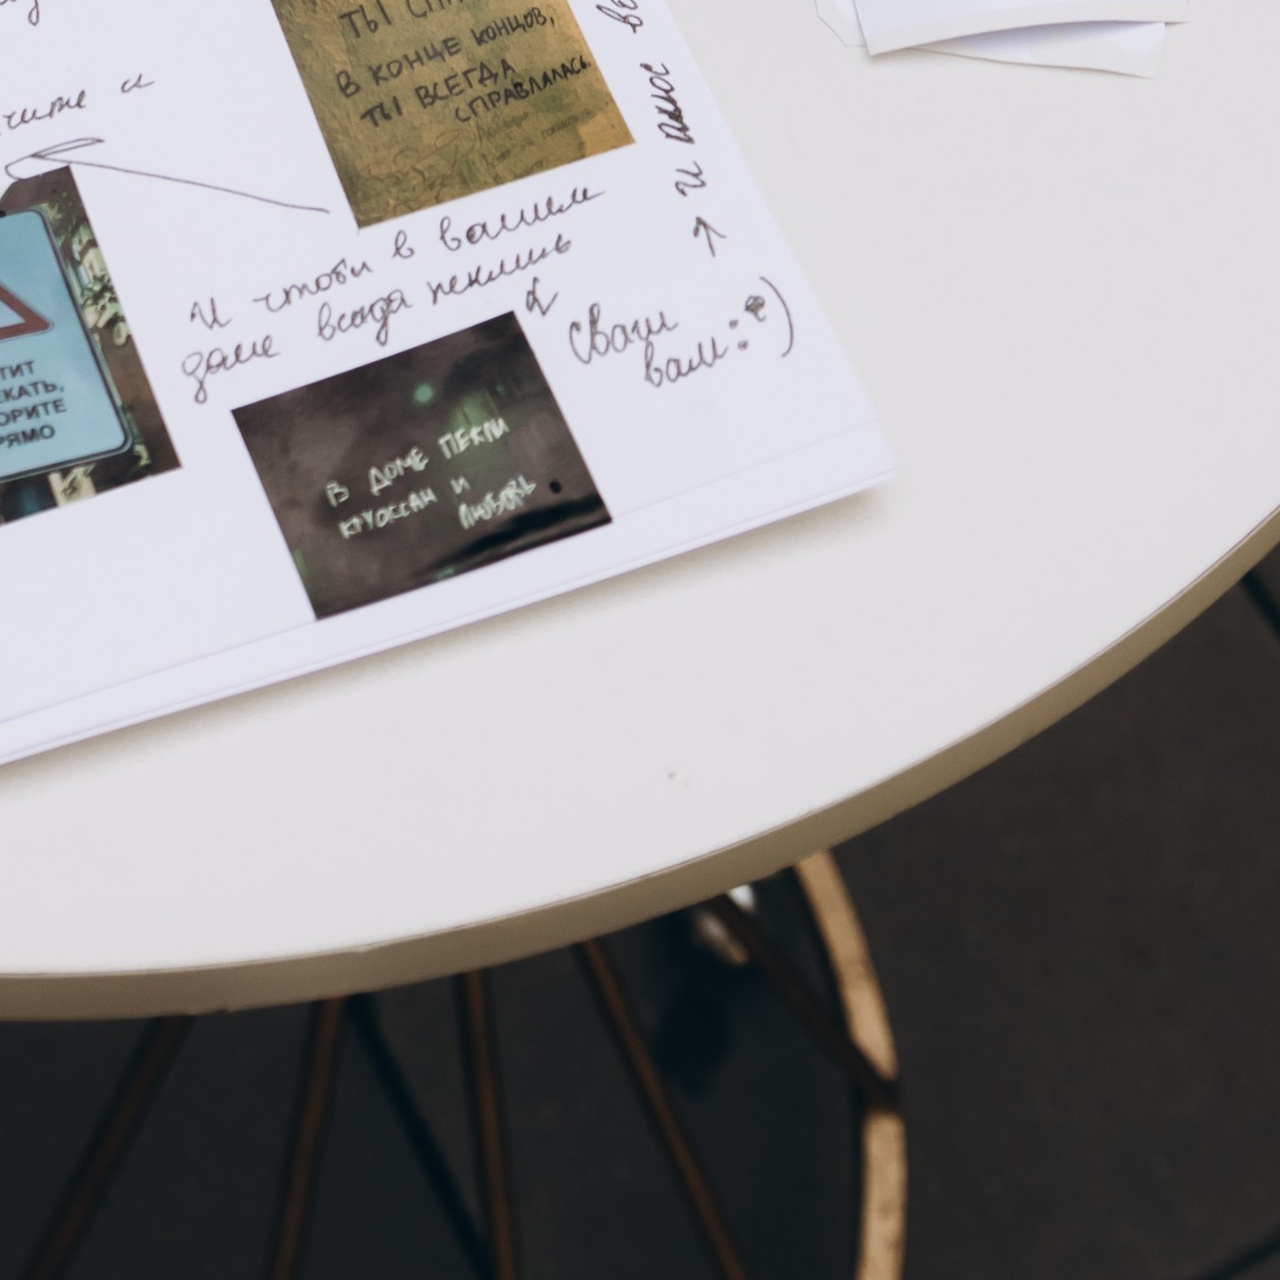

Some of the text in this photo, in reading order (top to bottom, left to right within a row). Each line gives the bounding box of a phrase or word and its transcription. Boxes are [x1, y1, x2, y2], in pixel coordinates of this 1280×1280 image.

[339, 0, 392, 39] ТЫ
[335, 70, 360, 98] В
[370, 37, 461, 87] КОНЦЕ
[360, 59, 516, 127] ТЫ ВСЕГДА
[393, 229, 414, 259] в
[325, 482, 350, 507] В
[368, 446, 430, 496] ДОМЕ
